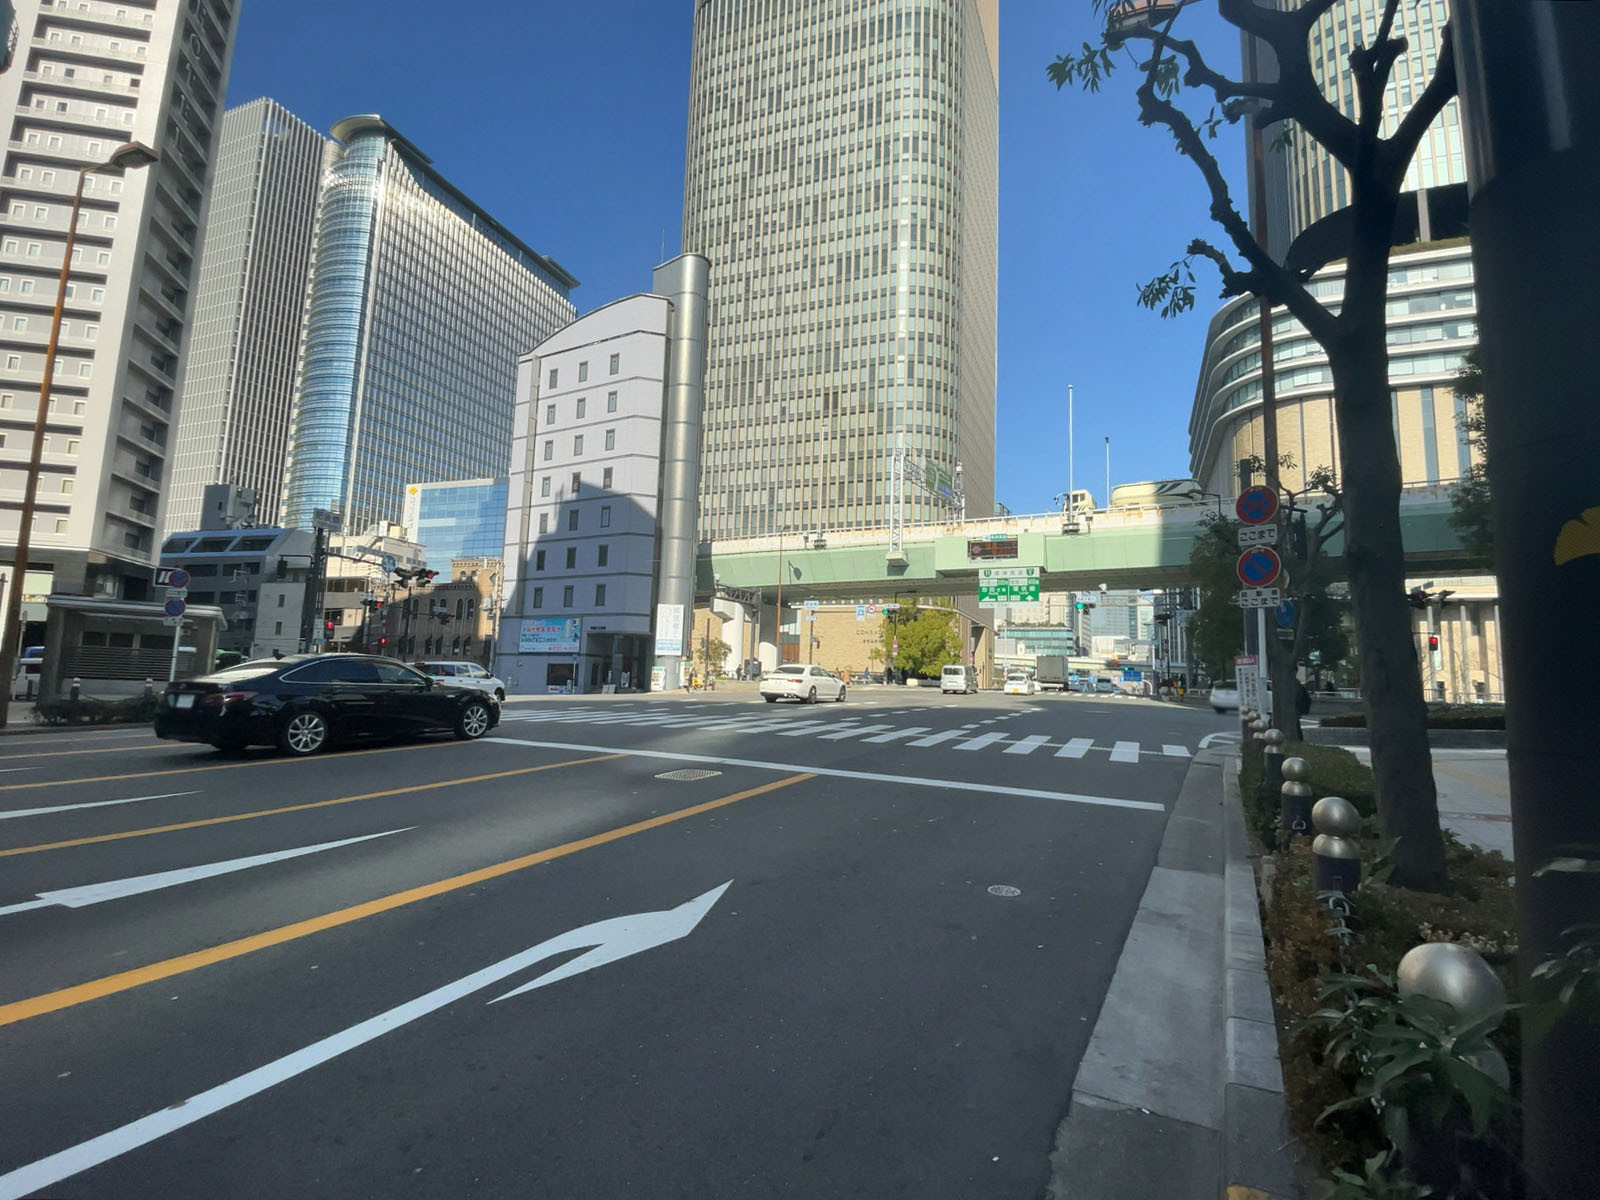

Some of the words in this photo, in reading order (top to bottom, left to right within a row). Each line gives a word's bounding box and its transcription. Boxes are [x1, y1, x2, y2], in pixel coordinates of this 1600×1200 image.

[1240, 528, 1275, 542] ここまで
[1241, 597, 1278, 607] ここまで
